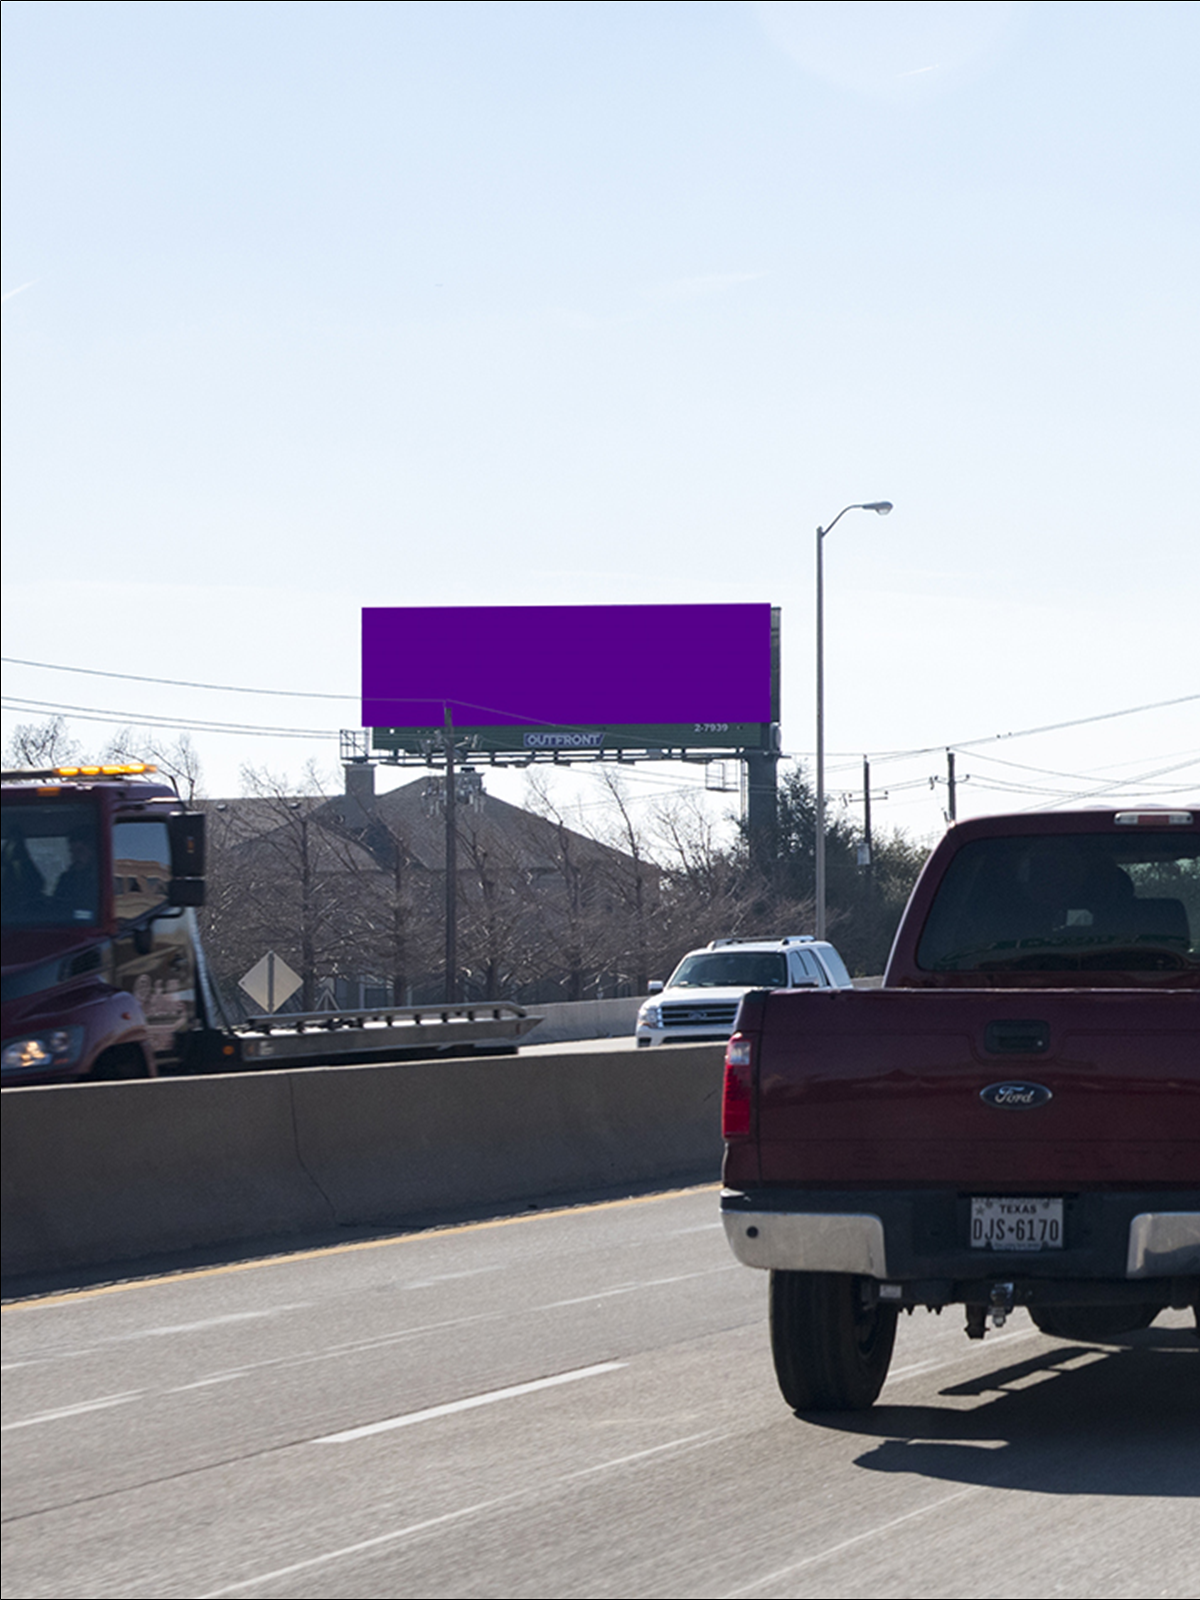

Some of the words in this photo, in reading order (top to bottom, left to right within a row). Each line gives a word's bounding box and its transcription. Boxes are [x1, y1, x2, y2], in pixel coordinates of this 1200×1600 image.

[694, 723, 729, 732] 2-7939
[527, 734, 600, 746] OUTFRONT
[994, 1085, 1035, 1103] Ford
[1000, 1204, 1037, 1214] TEXAS
